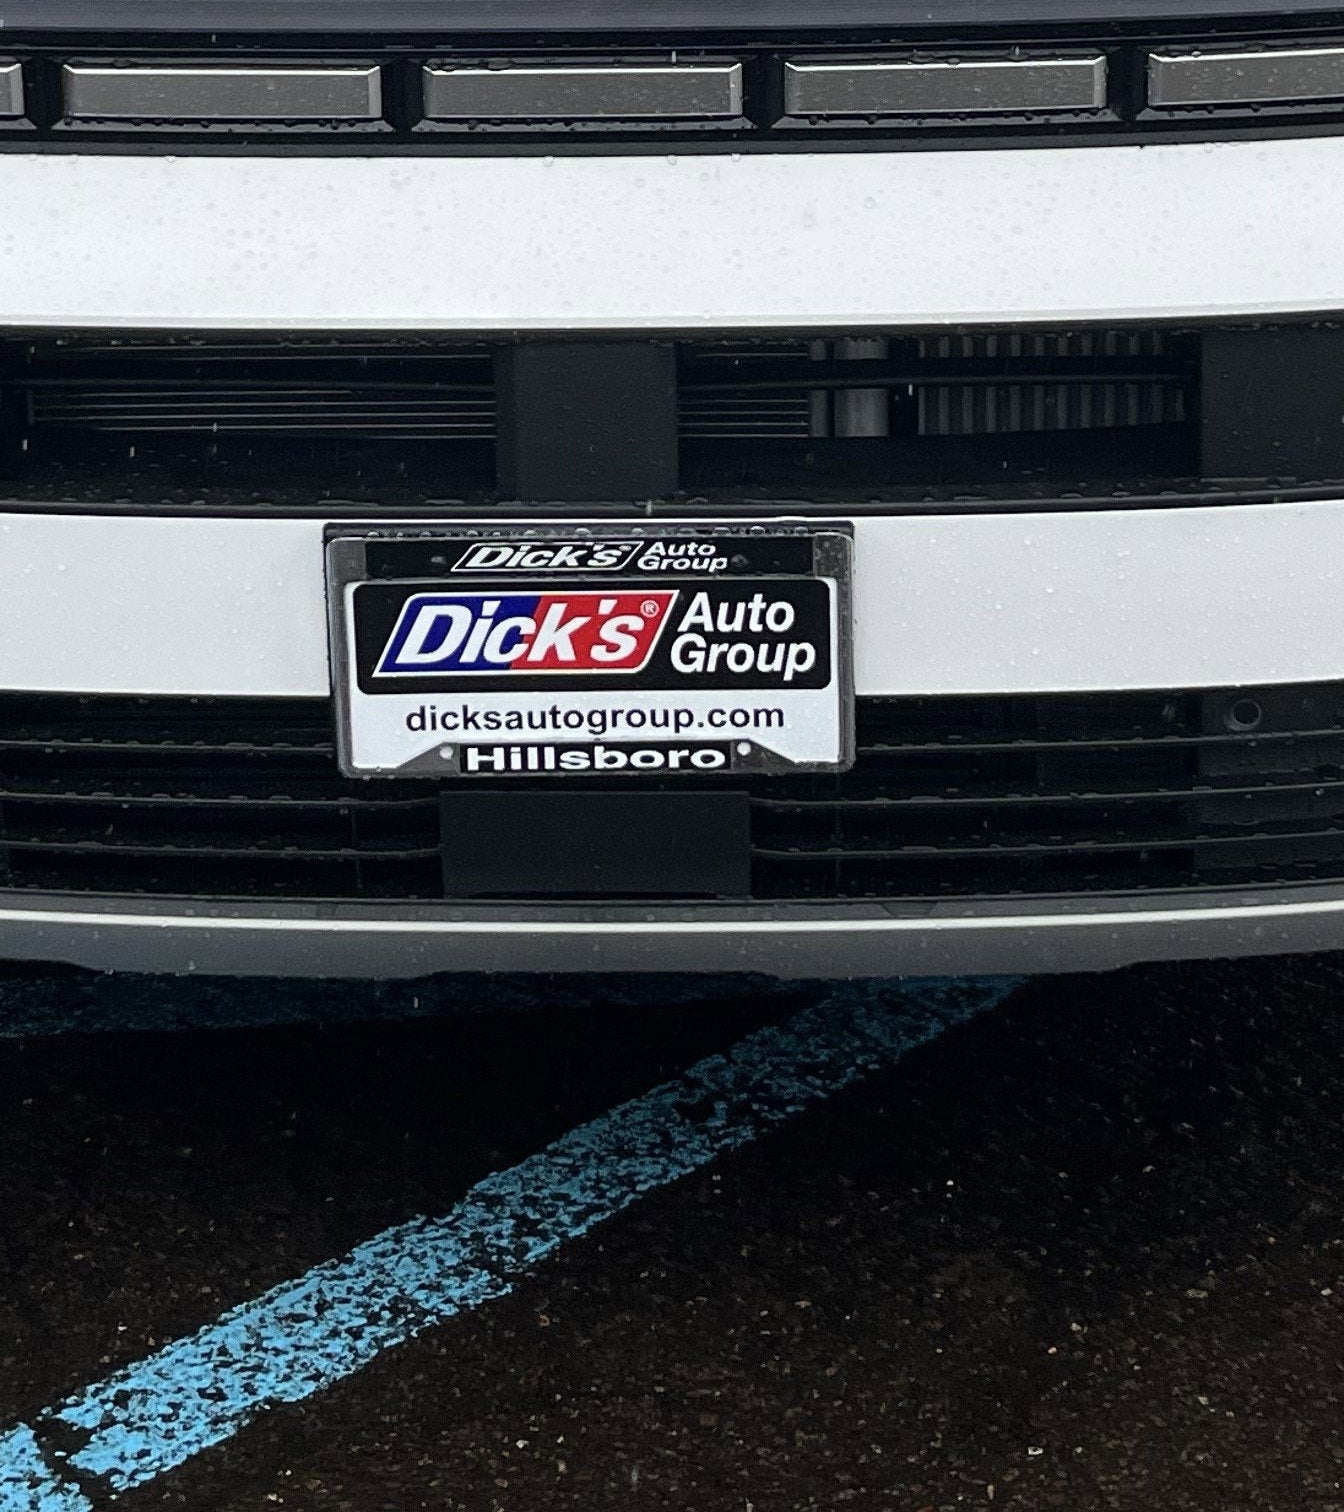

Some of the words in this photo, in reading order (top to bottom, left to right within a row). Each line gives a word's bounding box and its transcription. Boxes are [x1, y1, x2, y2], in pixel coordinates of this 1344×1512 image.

[465, 542, 623, 568] Dick's
[644, 541, 716, 556] Auto
[637, 555, 728, 572] Group
[394, 600, 645, 665] Dick's
[678, 592, 795, 634] Auto
[670, 635, 816, 681] Group
[405, 705, 785, 734] dicksautogroup.com
[466, 745, 726, 771] Hillsboro
